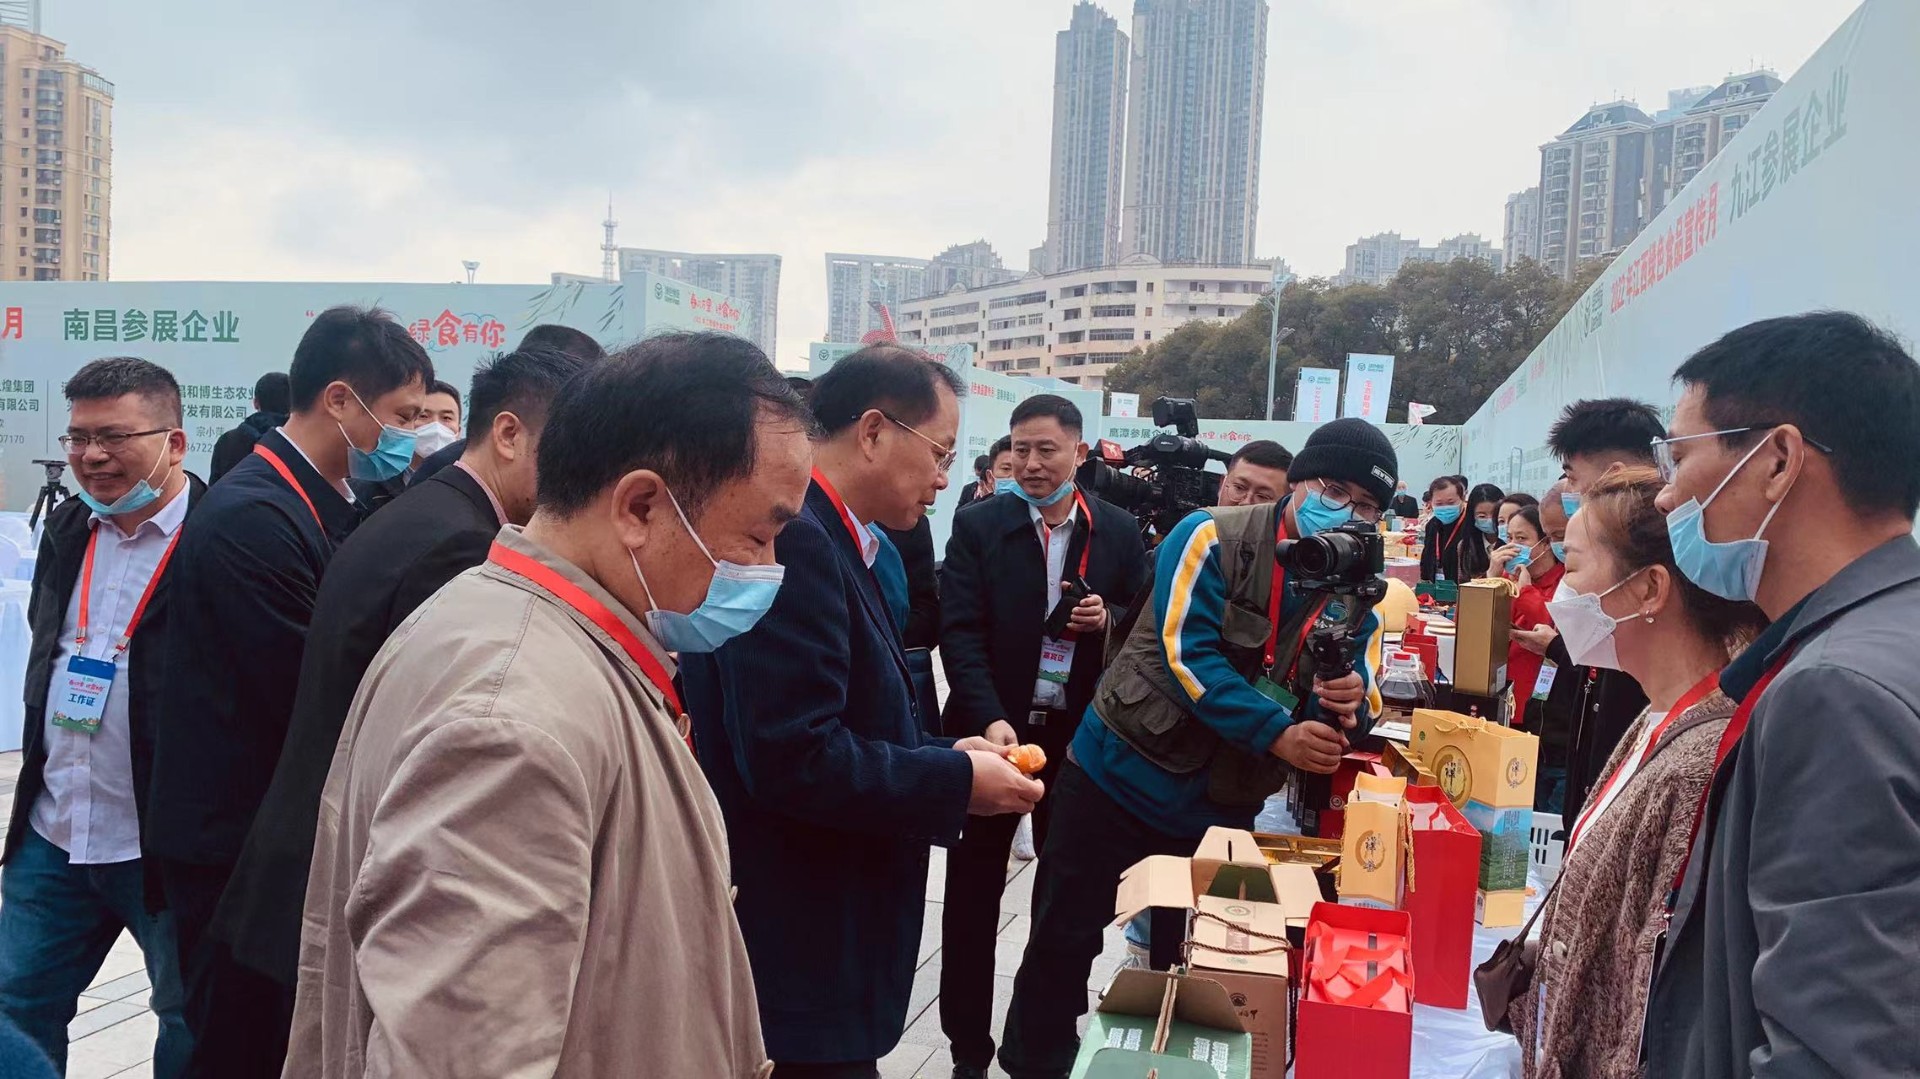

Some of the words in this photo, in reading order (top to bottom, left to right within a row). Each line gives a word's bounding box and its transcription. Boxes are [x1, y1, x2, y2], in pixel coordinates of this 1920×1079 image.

[1729, 65, 1849, 225] 九江参展企业
[1, 307, 23, 340] 月
[63, 308, 240, 343] 南昌参展企业
[408, 309, 506, 348] 绿食有你
[0, 379, 34, 393] 煌集团
[68, 693, 96, 707] 工作证
